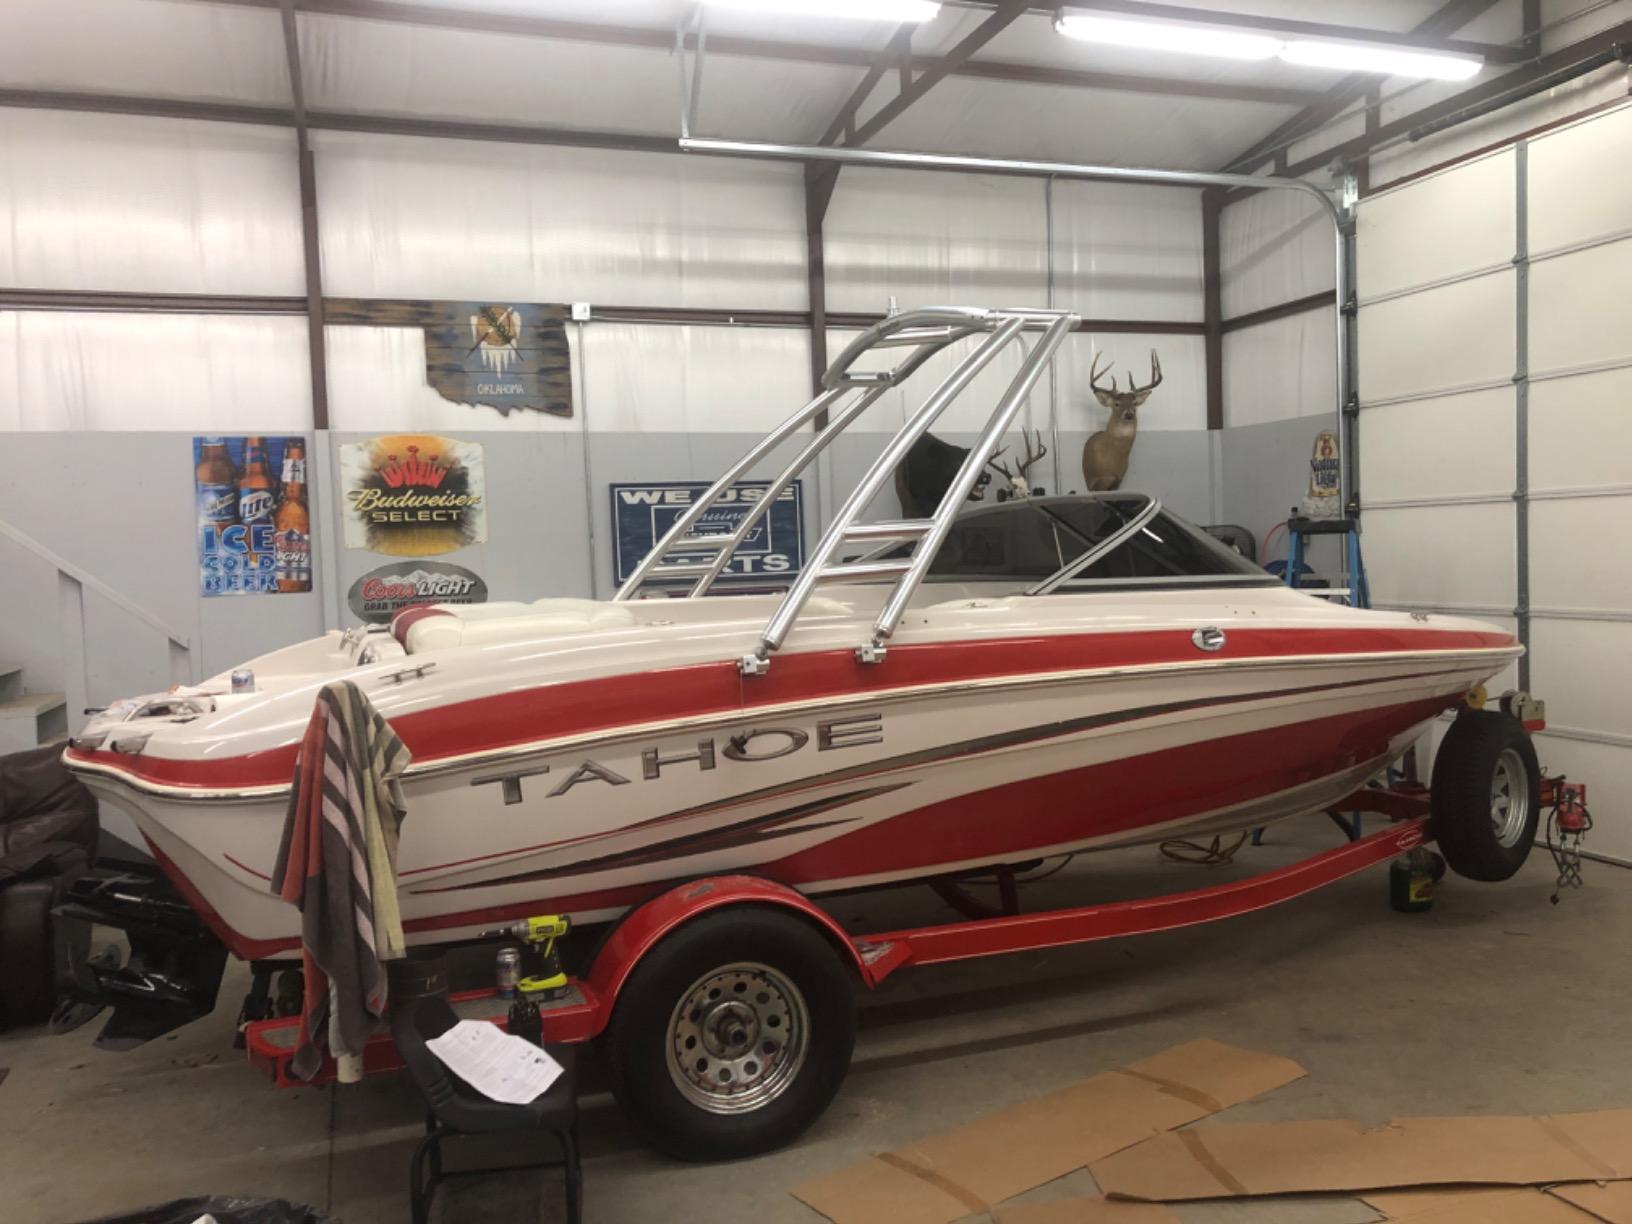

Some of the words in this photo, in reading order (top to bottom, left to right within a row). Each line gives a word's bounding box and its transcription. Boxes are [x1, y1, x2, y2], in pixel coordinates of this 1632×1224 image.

[477, 383, 525, 395] OKLAHOMA
[347, 488, 481, 512] Budweiser
[619, 490, 692, 505] WE
[371, 510, 462, 523] SELECT
[202, 525, 275, 554] ICE
[202, 555, 276, 573] COLD
[203, 574, 279, 592] BEER
[362, 577, 417, 601] Coors
[417, 579, 476, 597] LIGHT
[470, 713, 884, 806] TAHOE
